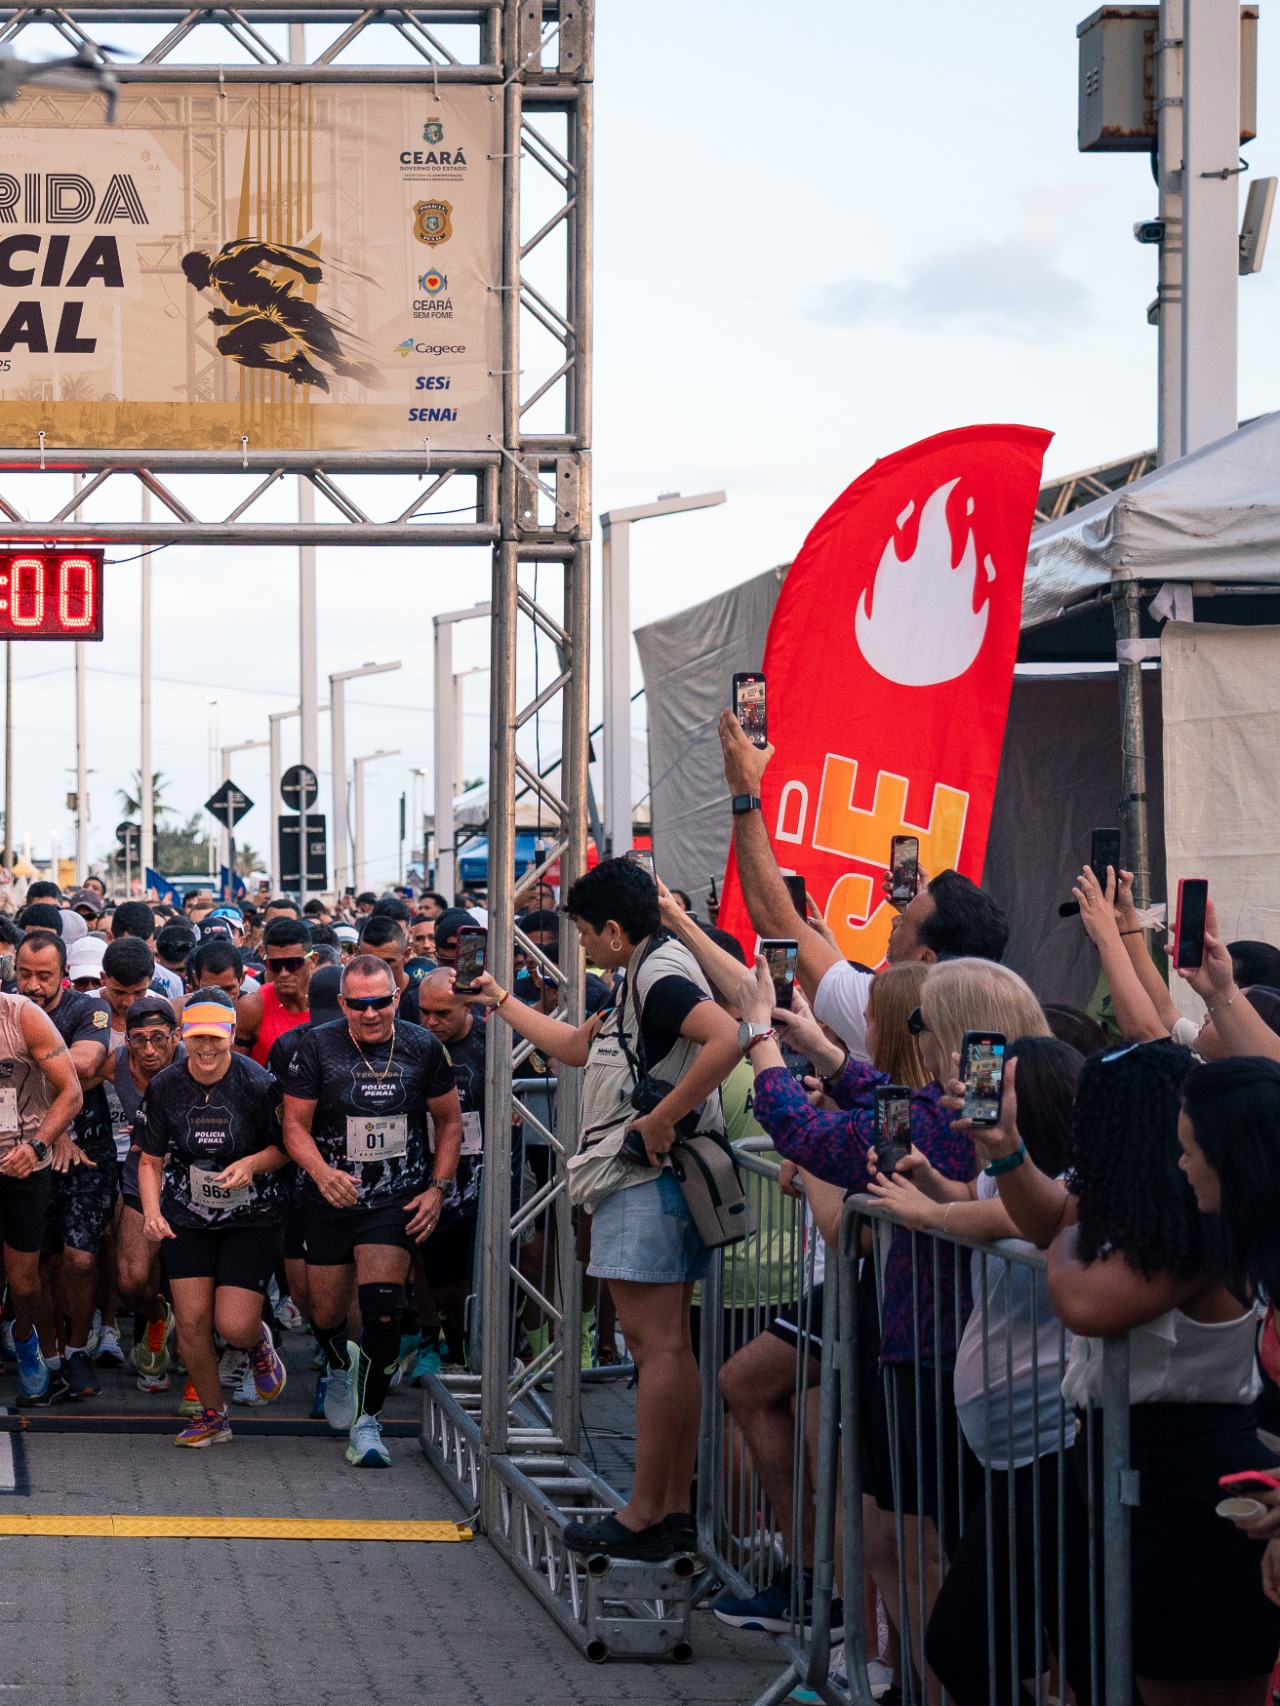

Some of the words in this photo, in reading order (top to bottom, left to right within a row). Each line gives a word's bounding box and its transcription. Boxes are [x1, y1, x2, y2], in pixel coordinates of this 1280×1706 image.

[399, 147, 467, 165] CEARÁ
[412, 297, 453, 311] CEARÁ
[412, 311, 430, 319] SEM
[431, 311, 454, 319] FOME
[415, 343, 466, 356] Cagece
[364, 1089, 394, 1097] PENAL
[366, 1132, 385, 1149] 01
[202, 1184, 231, 1199] 963
